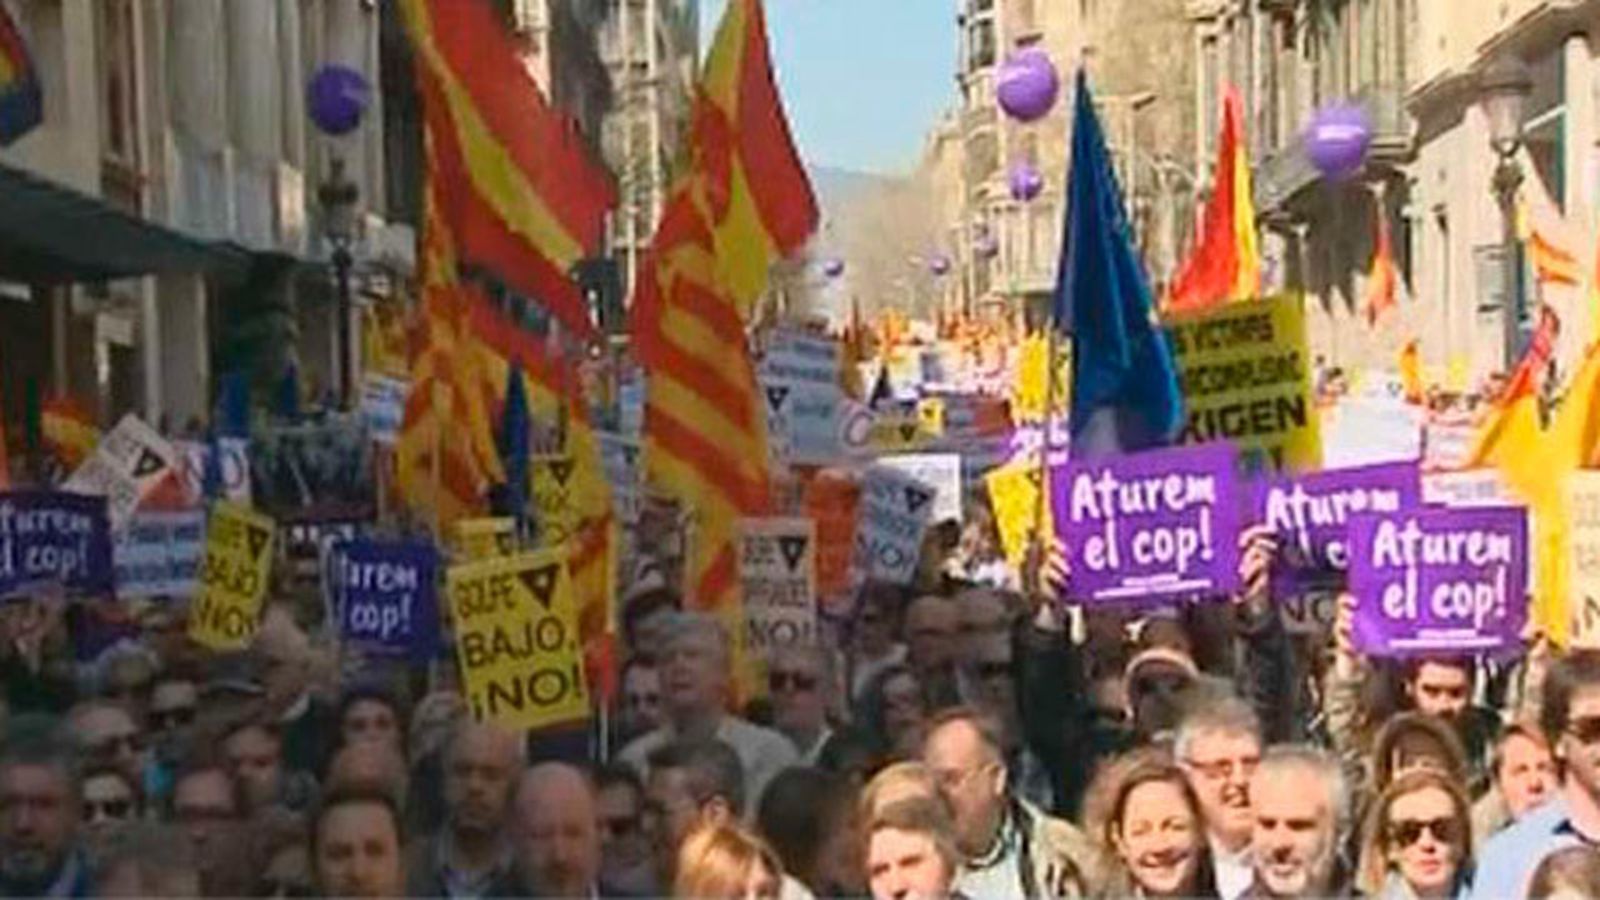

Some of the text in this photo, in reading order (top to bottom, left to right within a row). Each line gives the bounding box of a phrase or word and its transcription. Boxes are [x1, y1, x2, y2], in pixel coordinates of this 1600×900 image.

[1174, 395, 1307, 445] XIGEN
[0, 501, 92, 534] turem
[1072, 468, 1215, 522] Aturem
[25, 536, 90, 580] cop!
[1084, 505, 1214, 573] el cop!
[1372, 518, 1512, 567] Aturem
[1383, 564, 1506, 630] el cop!
